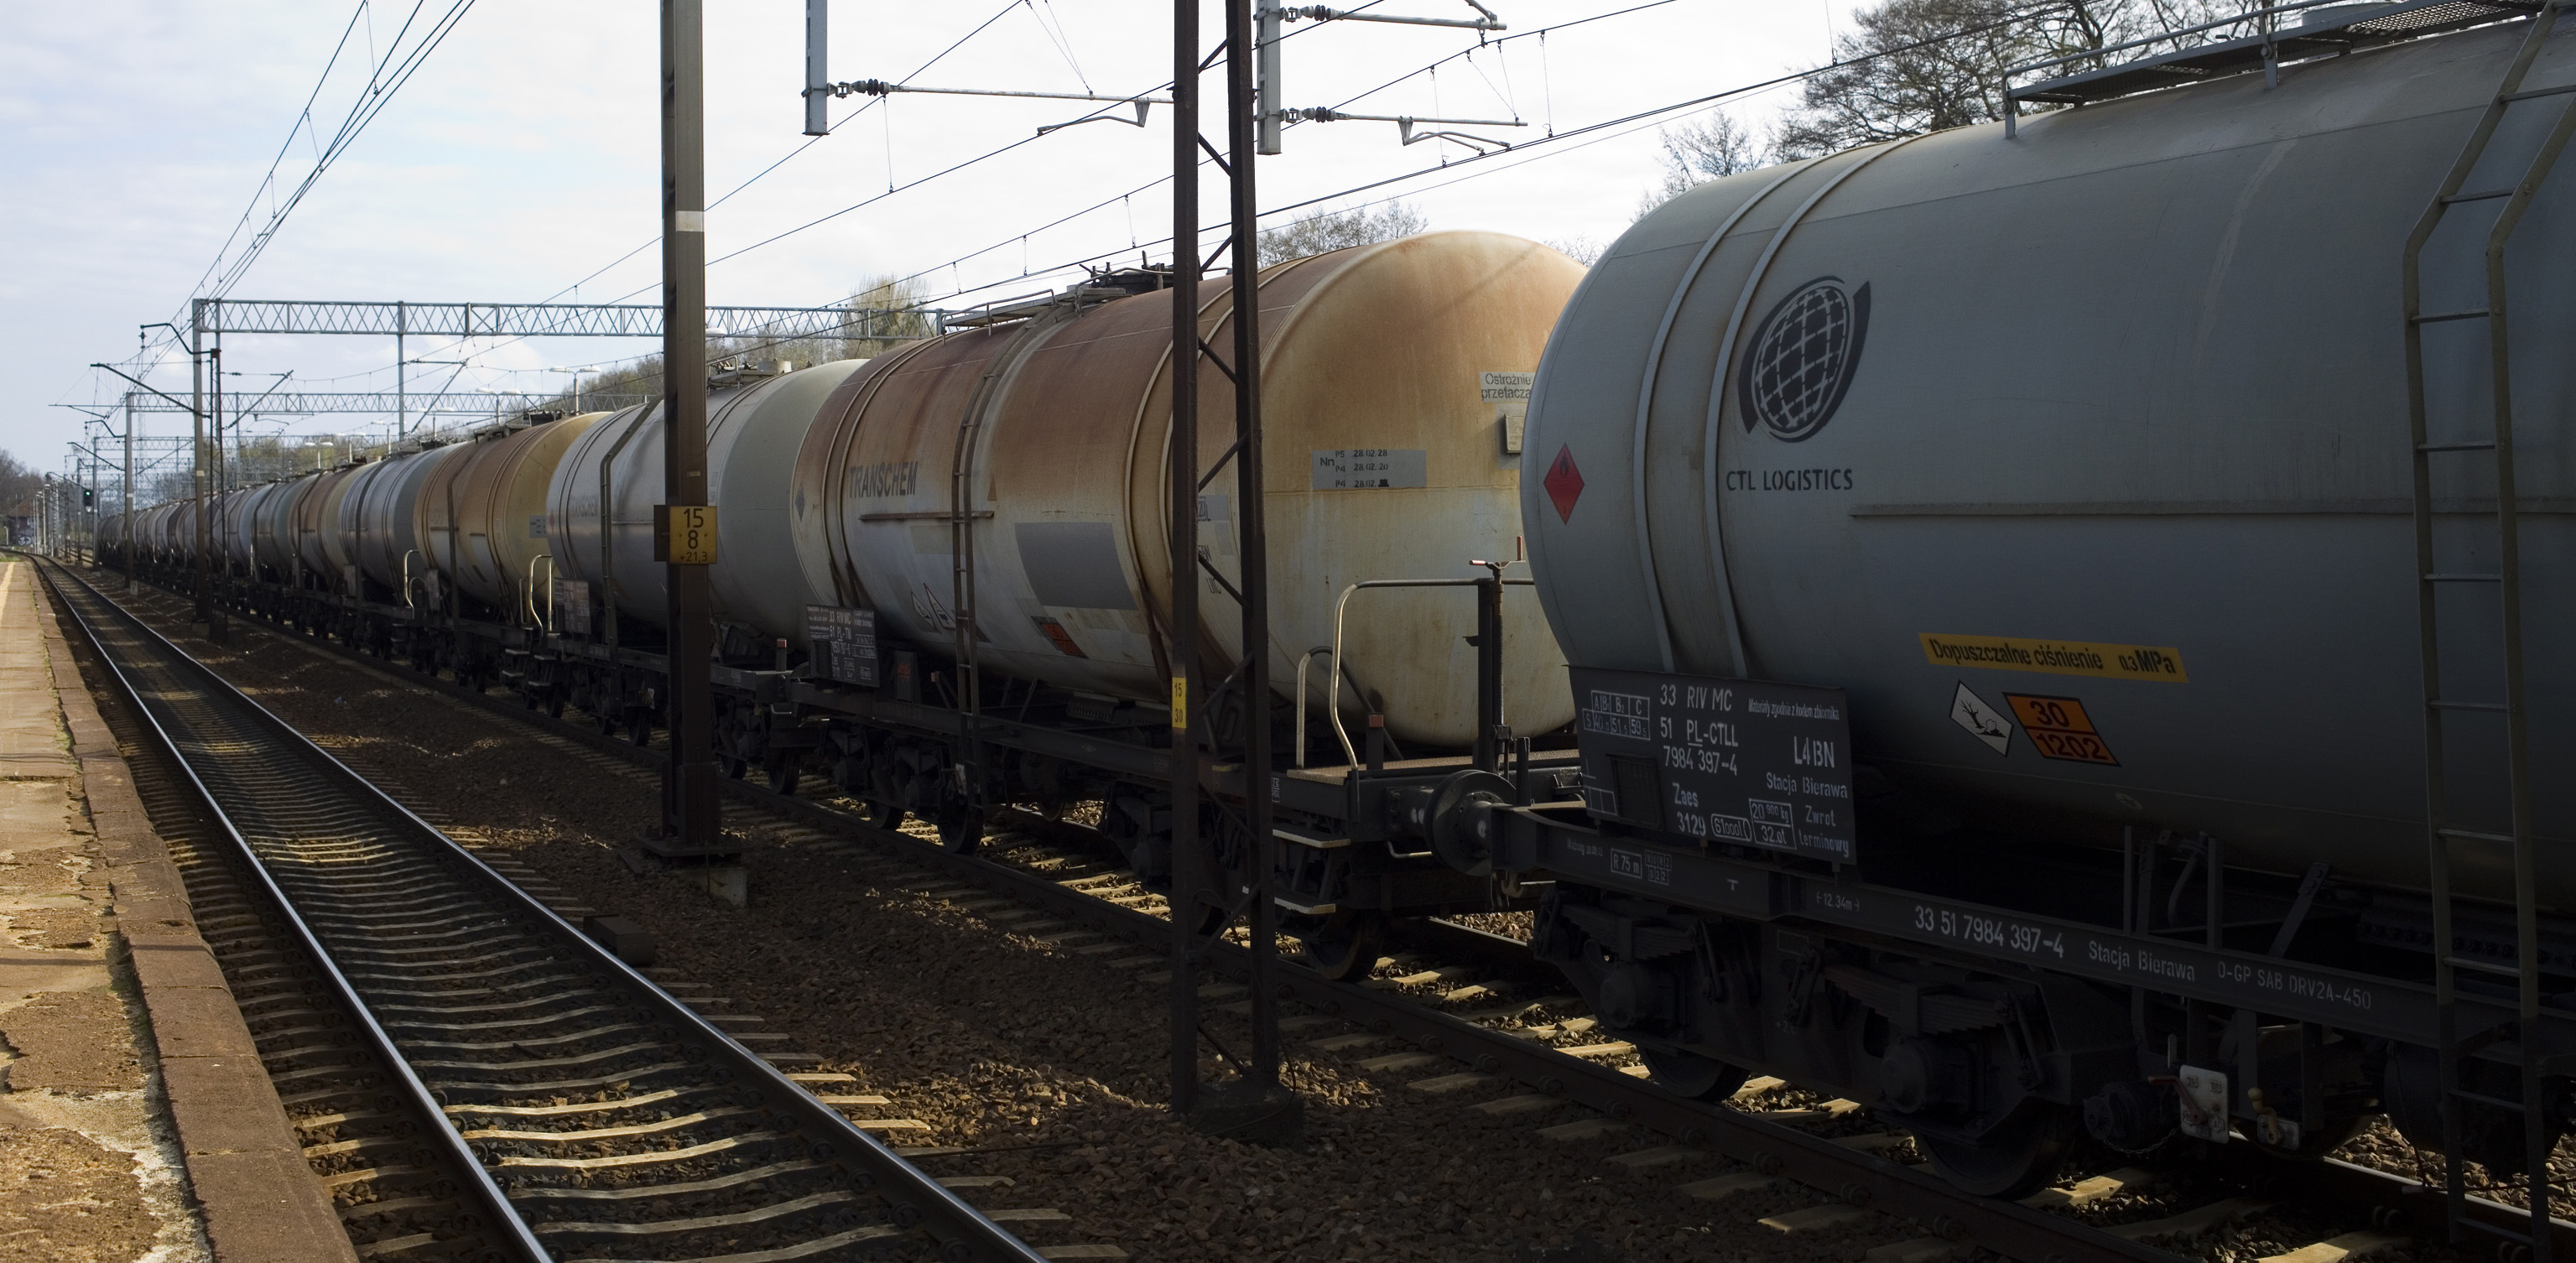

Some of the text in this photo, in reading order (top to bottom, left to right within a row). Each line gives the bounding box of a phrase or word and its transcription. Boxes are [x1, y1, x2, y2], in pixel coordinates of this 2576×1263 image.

[1481, 386, 1531, 401] przetacza
[849, 460, 919, 499] TRANSCHEM
[1725, 468, 1854, 491] CTL LOGISTICS
[683, 507, 704, 528] 15
[688, 529, 698, 549] 8
[679, 551, 707, 563] +21,3
[1928, 638, 2032, 665] Dopuszczalne
[2033, 645, 2103, 669] ciśnienie
[1174, 683, 1182, 697] 15
[1660, 683, 1733, 712] 33 RIV MC
[1174, 708, 1183, 723] 30
[1585, 712, 1591, 728] S
[1635, 699, 1642, 715] C
[1791, 704, 1795, 717] z
[1795, 702, 1813, 718] kodem
[2029, 700, 2069, 728] 30
[1660, 716, 1739, 747] 51 PL-CTLL
[1793, 735, 1835, 768] L4BN
[2036, 733, 2109, 761] 1202
[1663, 745, 1738, 777] 7984 397-4
[1672, 782, 1699, 808] Zaes
[1766, 771, 1849, 799] Stacja Bierawa
[1676, 811, 1707, 837] 3129
[1751, 803, 1789, 824] 20 900 kg
[1804, 804, 1836, 828] Zwrot
[1798, 828, 1850, 858] terminowy
[1613, 853, 1640, 874] R 75 m
[1914, 904, 2064, 959] 33 51 7984 397-4
[2088, 939, 2195, 982] Stacja Bierawa
[2257, 969, 2283, 991] SAB
[2288, 975, 2371, 1010] DRV2A-450
